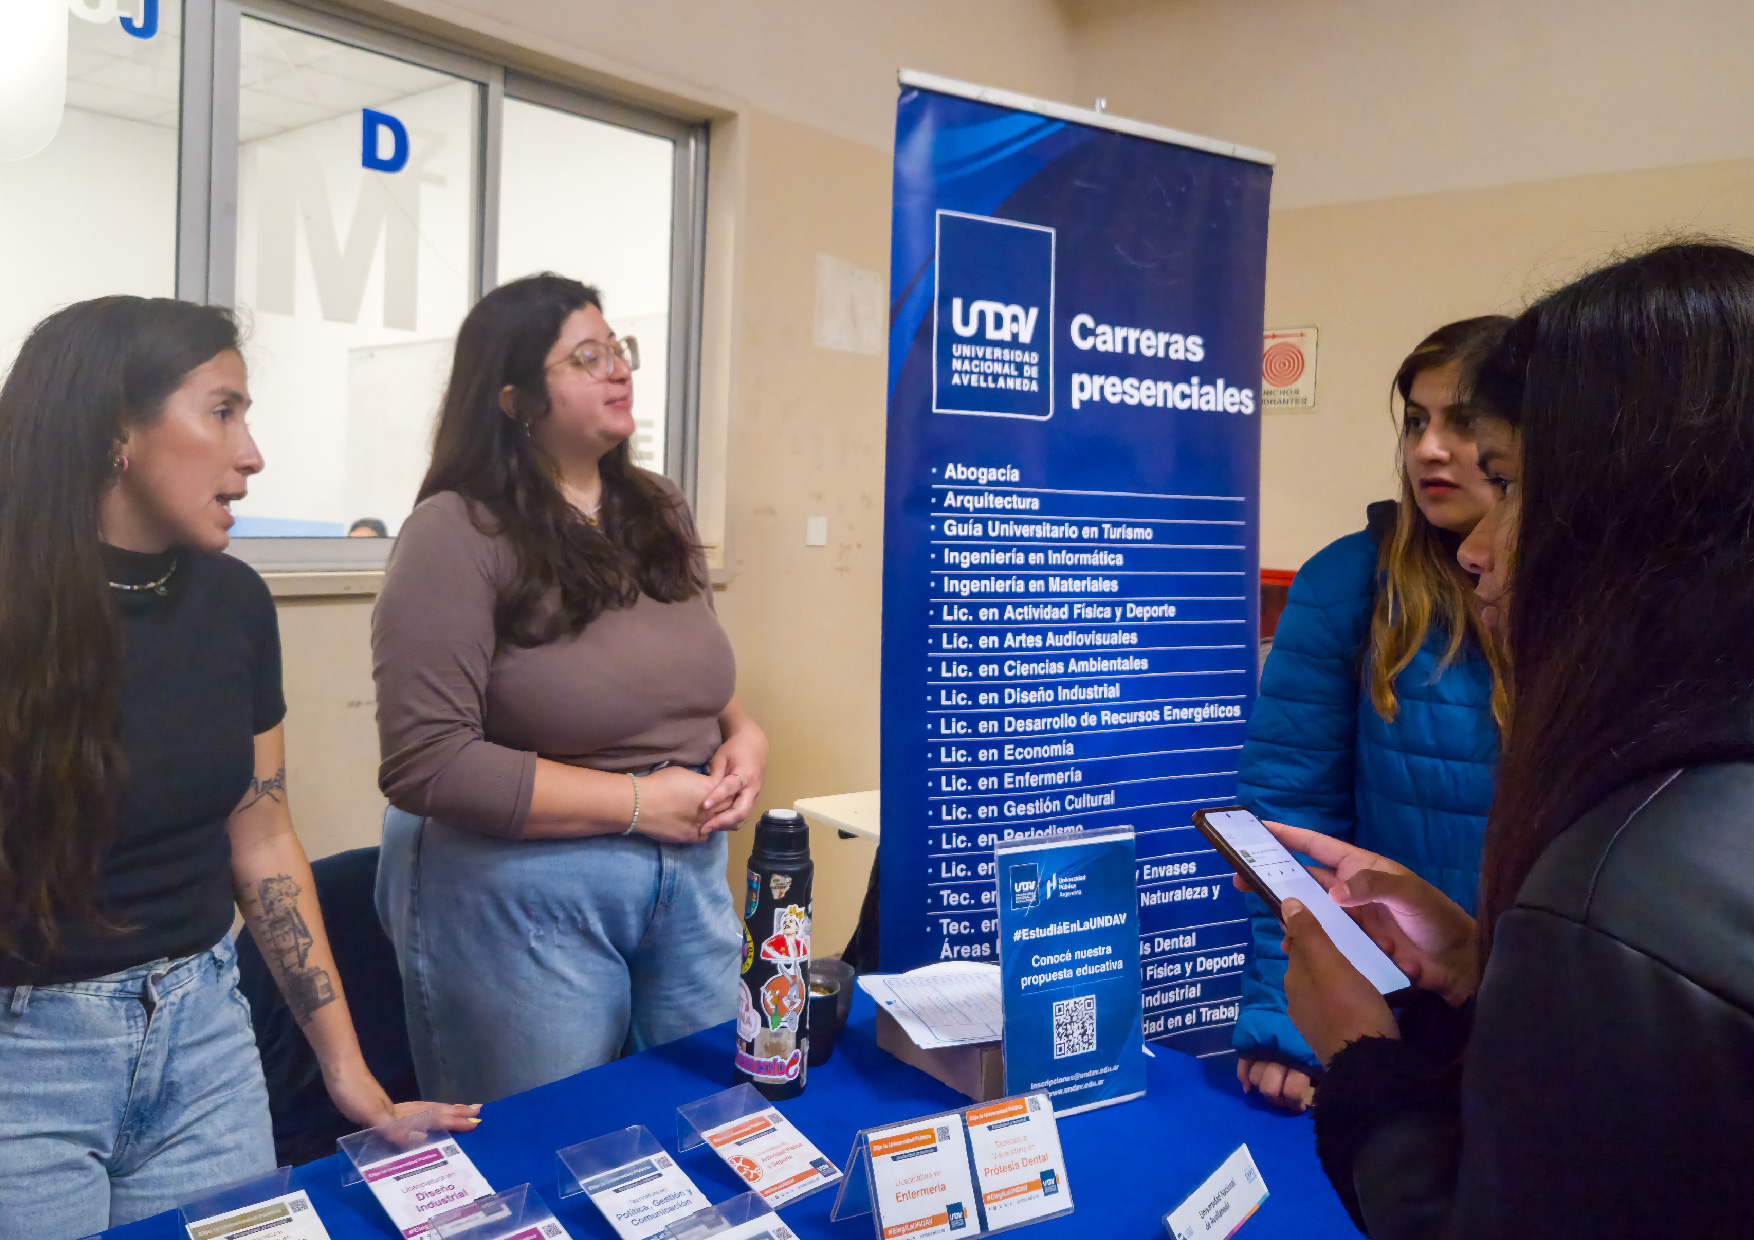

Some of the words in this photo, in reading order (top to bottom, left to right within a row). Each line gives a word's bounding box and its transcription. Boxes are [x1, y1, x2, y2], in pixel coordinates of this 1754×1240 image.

[361, 107, 410, 174] D
[1070, 313, 1205, 363] Carreras
[952, 344, 1039, 364] UNIVERSIDAD
[952, 358, 1018, 376] NACIONAL
[1023, 365, 1039, 379] DE
[952, 373, 1039, 393] AVELLANEDA
[1071, 371, 1256, 416] presenciales
[944, 463, 1021, 485] Abogacía
[944, 491, 1040, 512] Arquitectura
[944, 519, 983, 538] Guía
[988, 520, 1078, 539] Universitario
[1082, 524, 1099, 538] en
[1102, 523, 1153, 540] Turismo
[944, 548, 1025, 568] Ingeniería
[1028, 551, 1045, 565] en
[1048, 549, 1124, 566] Informática
[944, 576, 1025, 596] Ingeniería
[1028, 579, 1045, 593] en
[1049, 576, 1119, 593] Materiales
[943, 604, 973, 621] Lic.
[979, 606, 999, 620] en
[1004, 603, 1069, 620] Actividad
[1073, 603, 1111, 619] Física
[1115, 606, 1123, 623] y
[1126, 603, 1176, 621] Deporte
[942, 632, 973, 649] Lic.
[979, 635, 999, 649] en
[1004, 632, 1042, 648] Artes
[1046, 630, 1138, 647] Audiovisuales
[941, 661, 973, 678] Lic.
[979, 663, 999, 677] en
[1004, 659, 1064, 676] Ciencias
[1067, 655, 1149, 673] Ambientales
[940, 689, 972, 706] Lic.
[978, 691, 999, 705] en
[1004, 685, 1054, 704] Diseño
[1058, 683, 1120, 701] Industrial
[940, 717, 972, 735] Lic.
[978, 720, 998, 734] en
[1004, 713, 1077, 732] Desarrollo
[1080, 711, 1097, 727] de
[1101, 707, 1160, 725] Recursos
[1164, 703, 1241, 722] Energéticos
[940, 746, 972, 762] Lic.
[978, 747, 998, 761] en
[1004, 740, 1074, 760] Economía
[941, 774, 972, 791] Lic.
[978, 776, 998, 790] en
[1004, 768, 1082, 788] Enfermería
[941, 803, 972, 820] Lic.
[978, 805, 998, 818] en
[1004, 797, 1061, 817] Gestión
[1065, 790, 1115, 810] Cultural
[942, 832, 972, 849] Lic.
[978, 833, 997, 846] en
[941, 862, 972, 878] Lic.
[940, 889, 975, 906] Tec.
[1143, 862, 1196, 880] Envases
[939, 918, 975, 935] Tec.
[1141, 886, 1208, 907] Naturaleza
[1212, 884, 1220, 900] y
[1013, 912, 1127, 943] #EstudiáEnLaUNDAV
[940, 938, 990, 960] Áreas
[1155, 932, 1196, 953] Dental
[1031, 949, 1072, 968] Conocé
[1074, 944, 1112, 960] nuestra
[1146, 963, 1181, 980] Física
[1185, 961, 1193, 977] y
[1196, 952, 1245, 973] Deporte
[1021, 968, 1074, 989] propuesta
[1076, 958, 1123, 977] educativa
[1142, 983, 1201, 1009] Industrial
[1167, 1015, 1182, 1029] en
[1185, 1009, 1196, 1026] el
[1200, 1002, 1240, 1023] Trabaj
[1021, 1152, 1049, 1168] Dental
[415, 1183, 455, 1201] Diseño
[416, 1188, 469, 1213] Industrial
[896, 1182, 947, 1203] Enfermería
